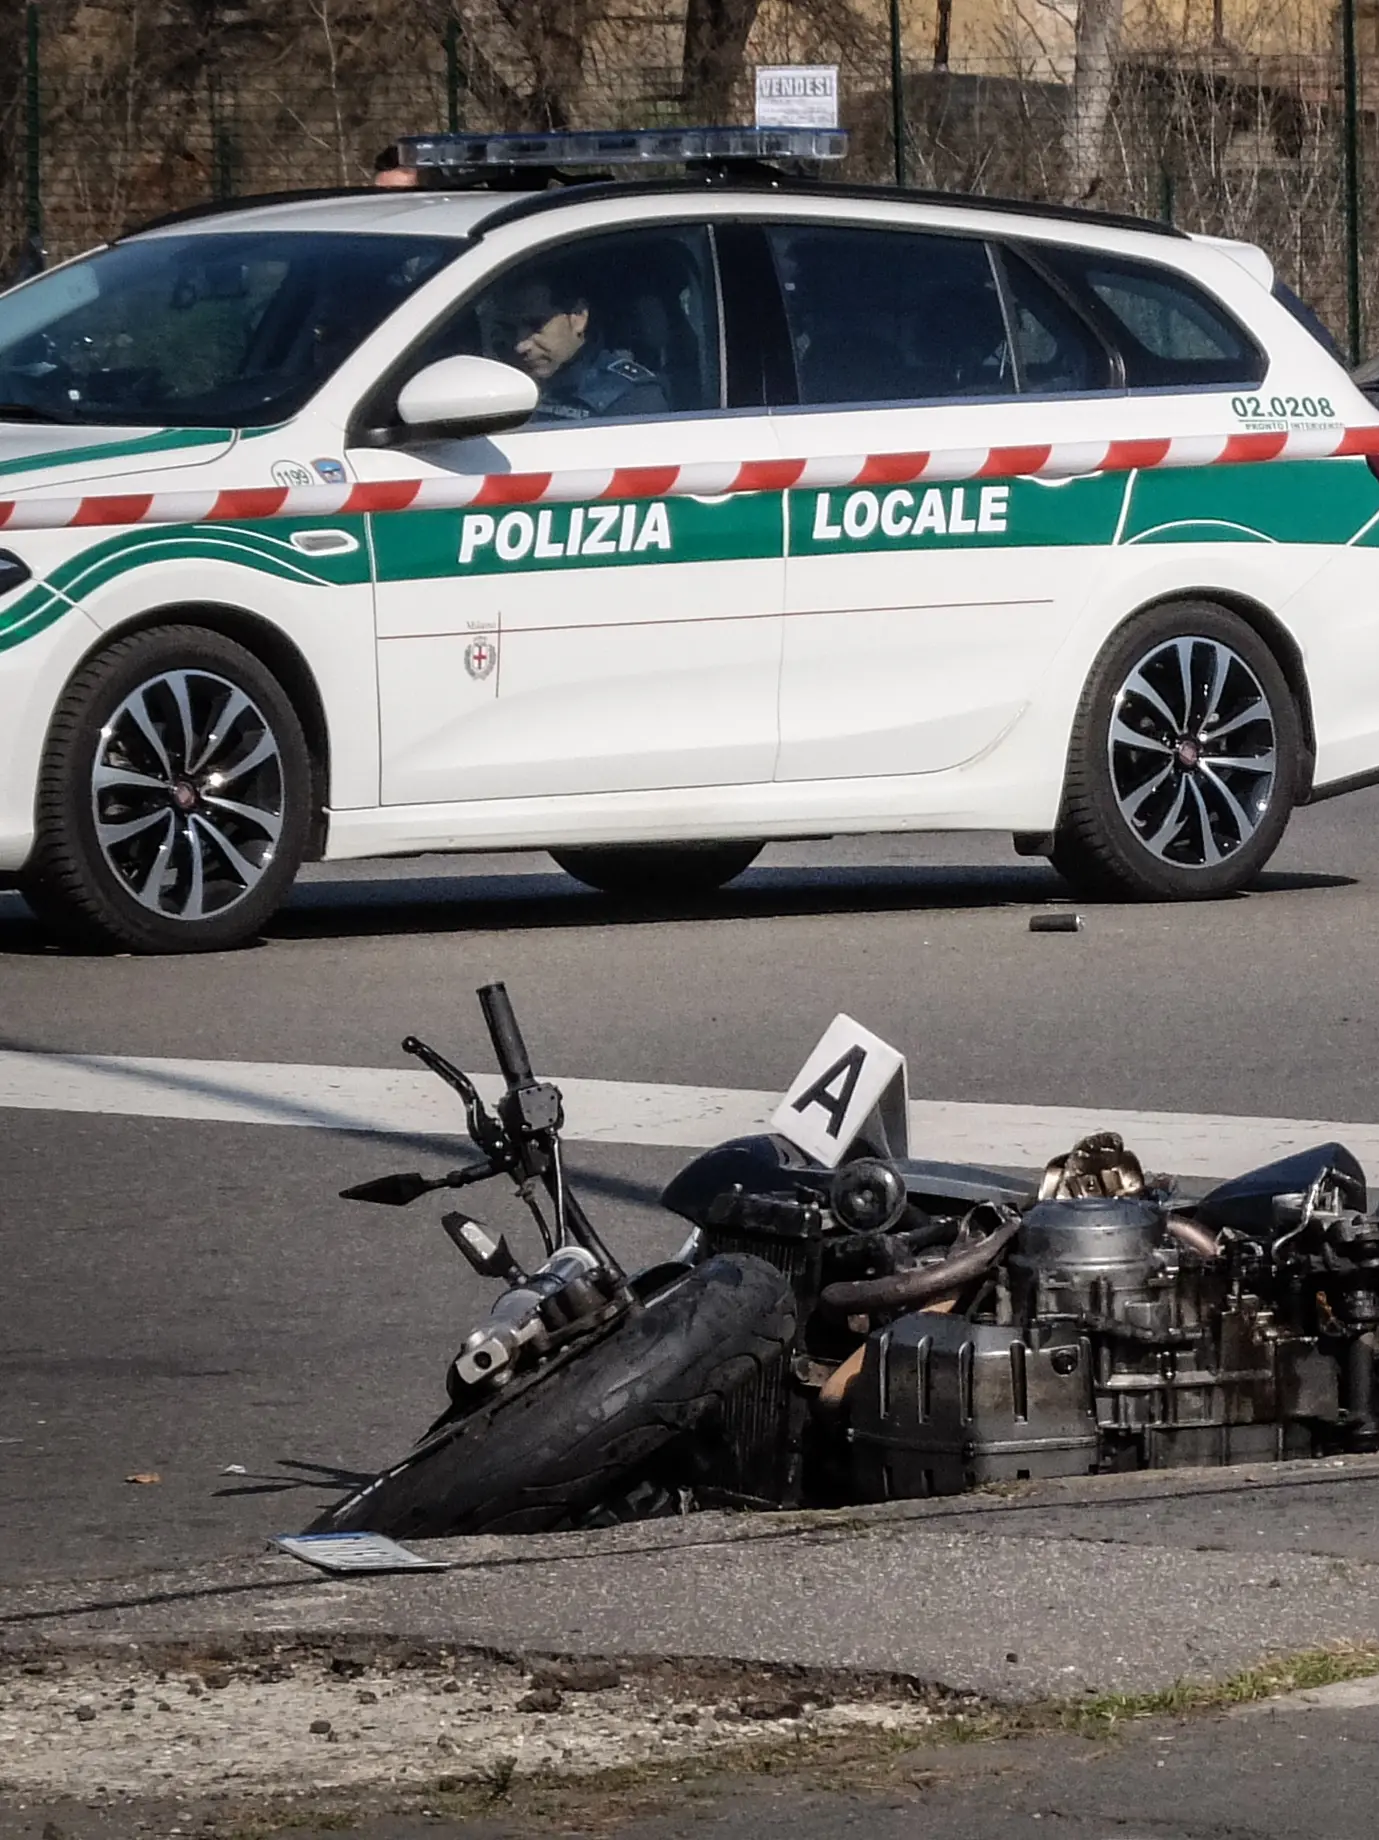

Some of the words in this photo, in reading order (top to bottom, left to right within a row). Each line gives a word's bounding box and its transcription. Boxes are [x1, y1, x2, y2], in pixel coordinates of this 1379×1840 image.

[760, 77, 833, 97] VENDESI
[1231, 396, 1336, 418] 02.0208
[458, 502, 672, 564] POLIZIA
[812, 486, 1010, 540] LOCALE
[790, 1043, 868, 1140] A
